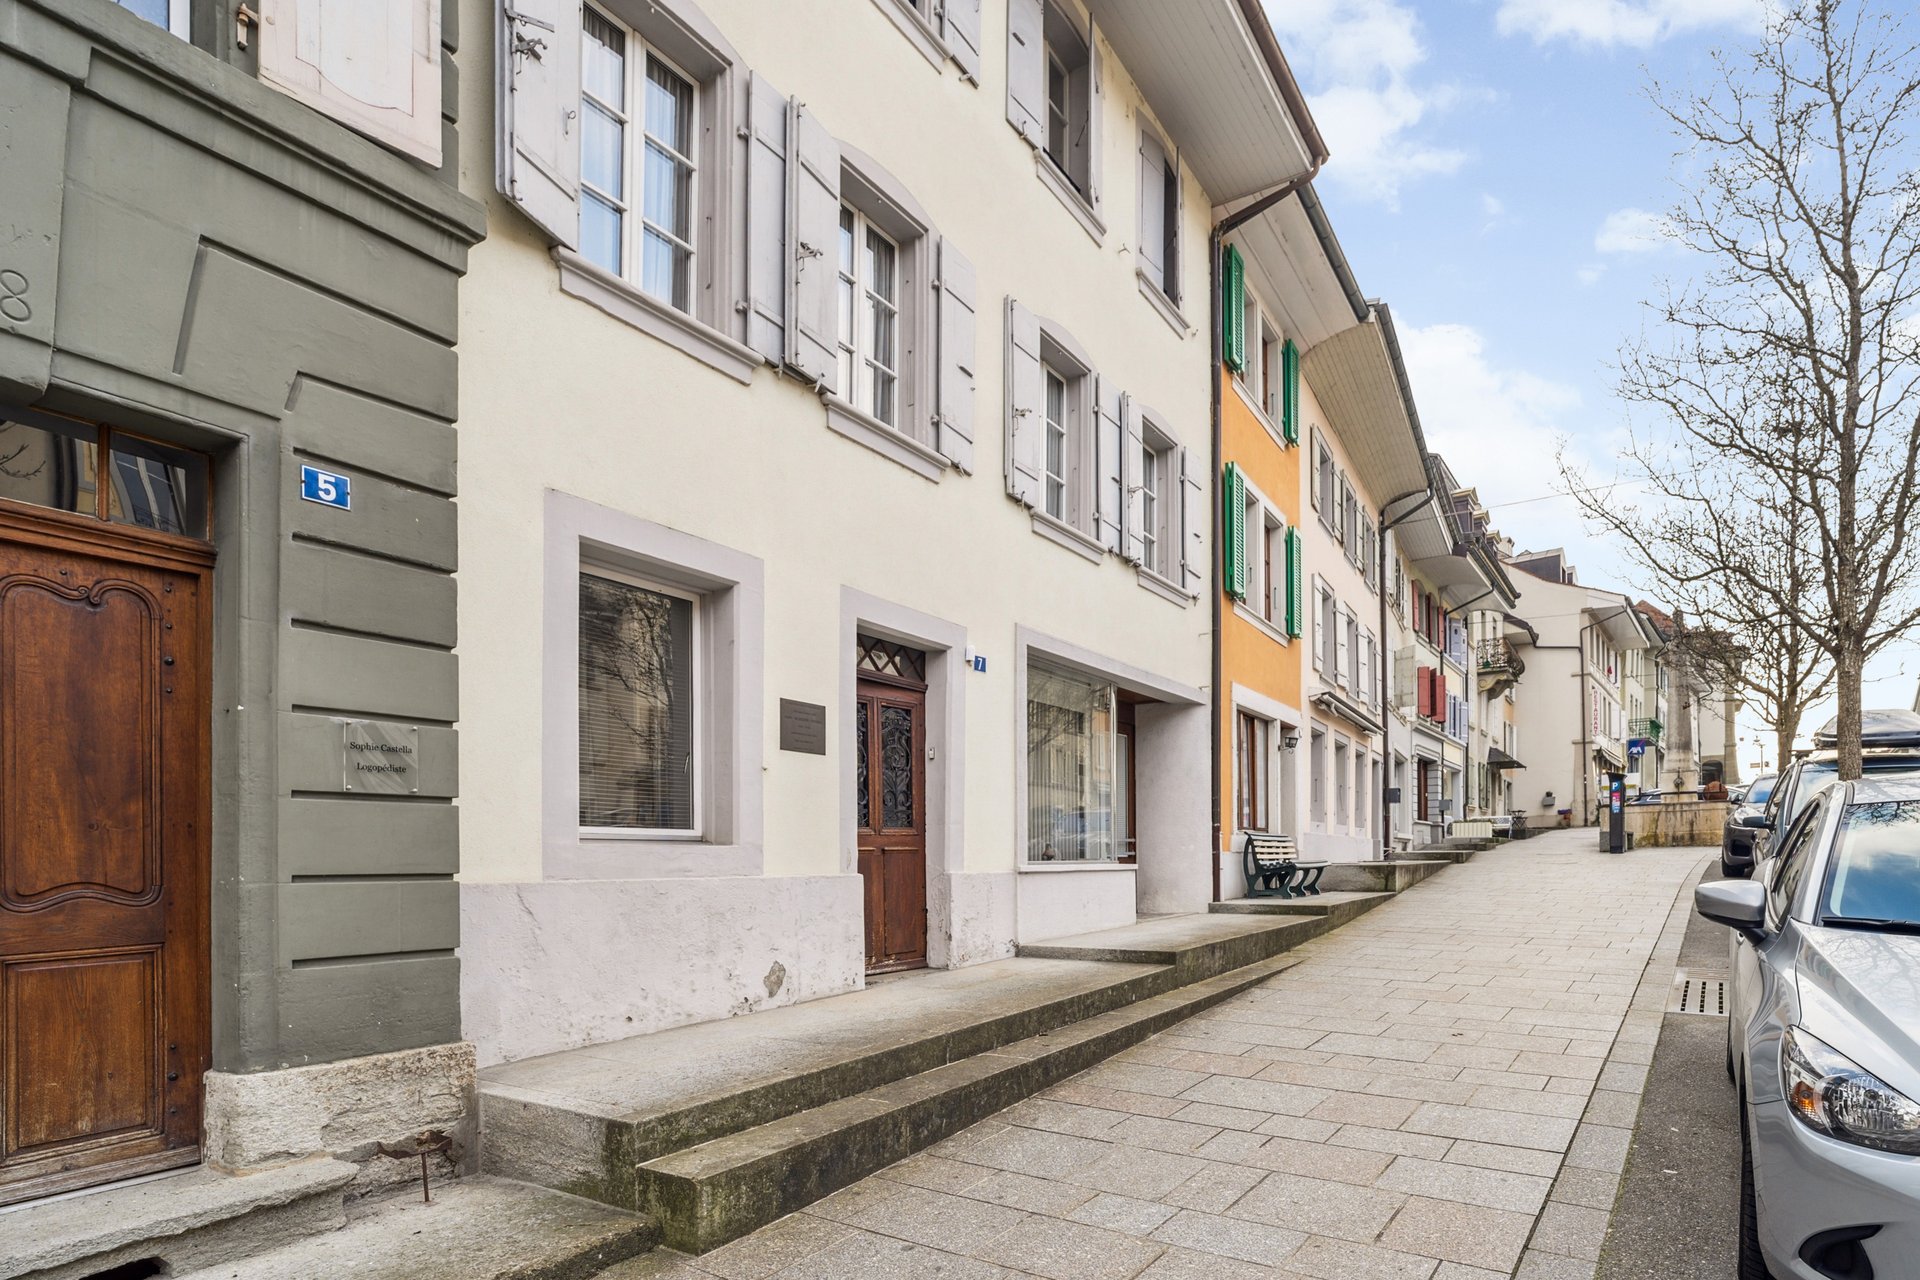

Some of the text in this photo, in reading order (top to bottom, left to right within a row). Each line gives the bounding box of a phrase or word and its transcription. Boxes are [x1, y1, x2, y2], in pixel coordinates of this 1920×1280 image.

[318, 473, 337, 501] 5
[349, 741, 413, 754] Sophie Castella
[1628, 746, 1643, 754] AXA
[356, 762, 407, 774] Logopédiste
[1612, 782, 1619, 790] P
